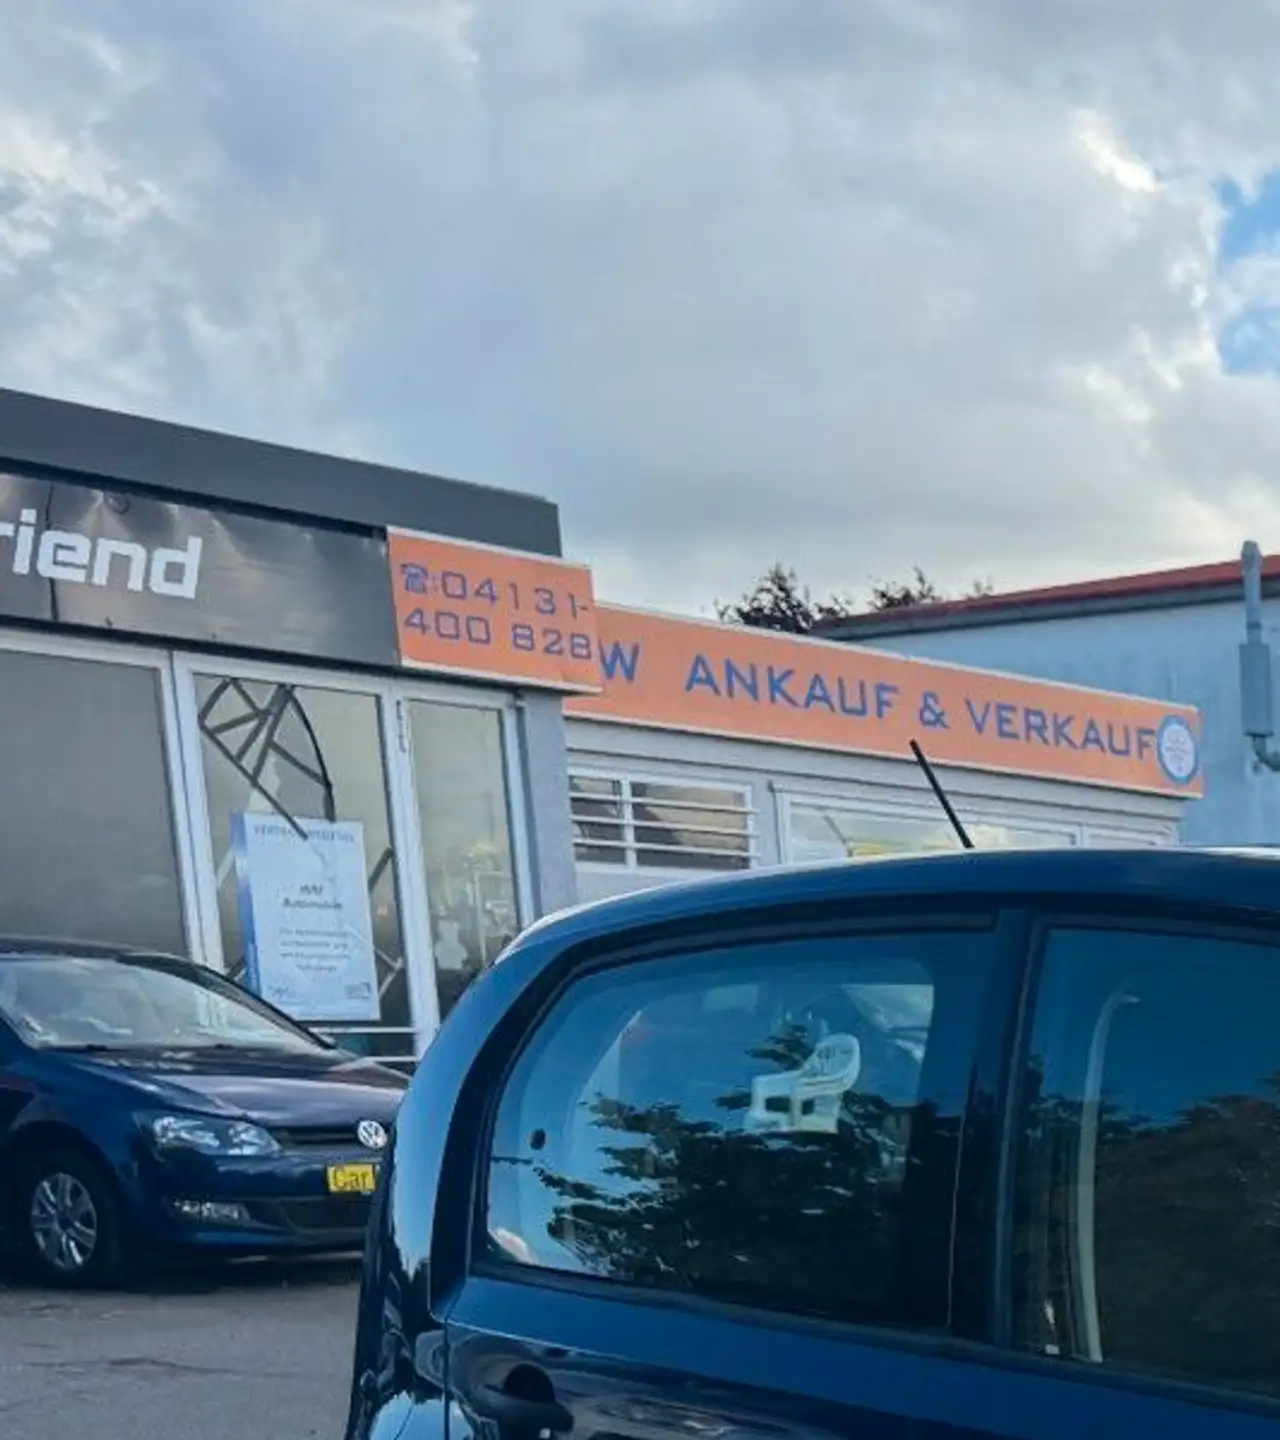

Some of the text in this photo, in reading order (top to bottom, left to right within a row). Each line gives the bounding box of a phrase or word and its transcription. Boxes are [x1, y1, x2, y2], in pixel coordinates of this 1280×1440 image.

[404, 607, 591, 660] 400 828
[684, 653, 899, 719] ANKAUF
[919, 691, 949, 729] &
[964, 698, 1156, 761] VERKAUF
